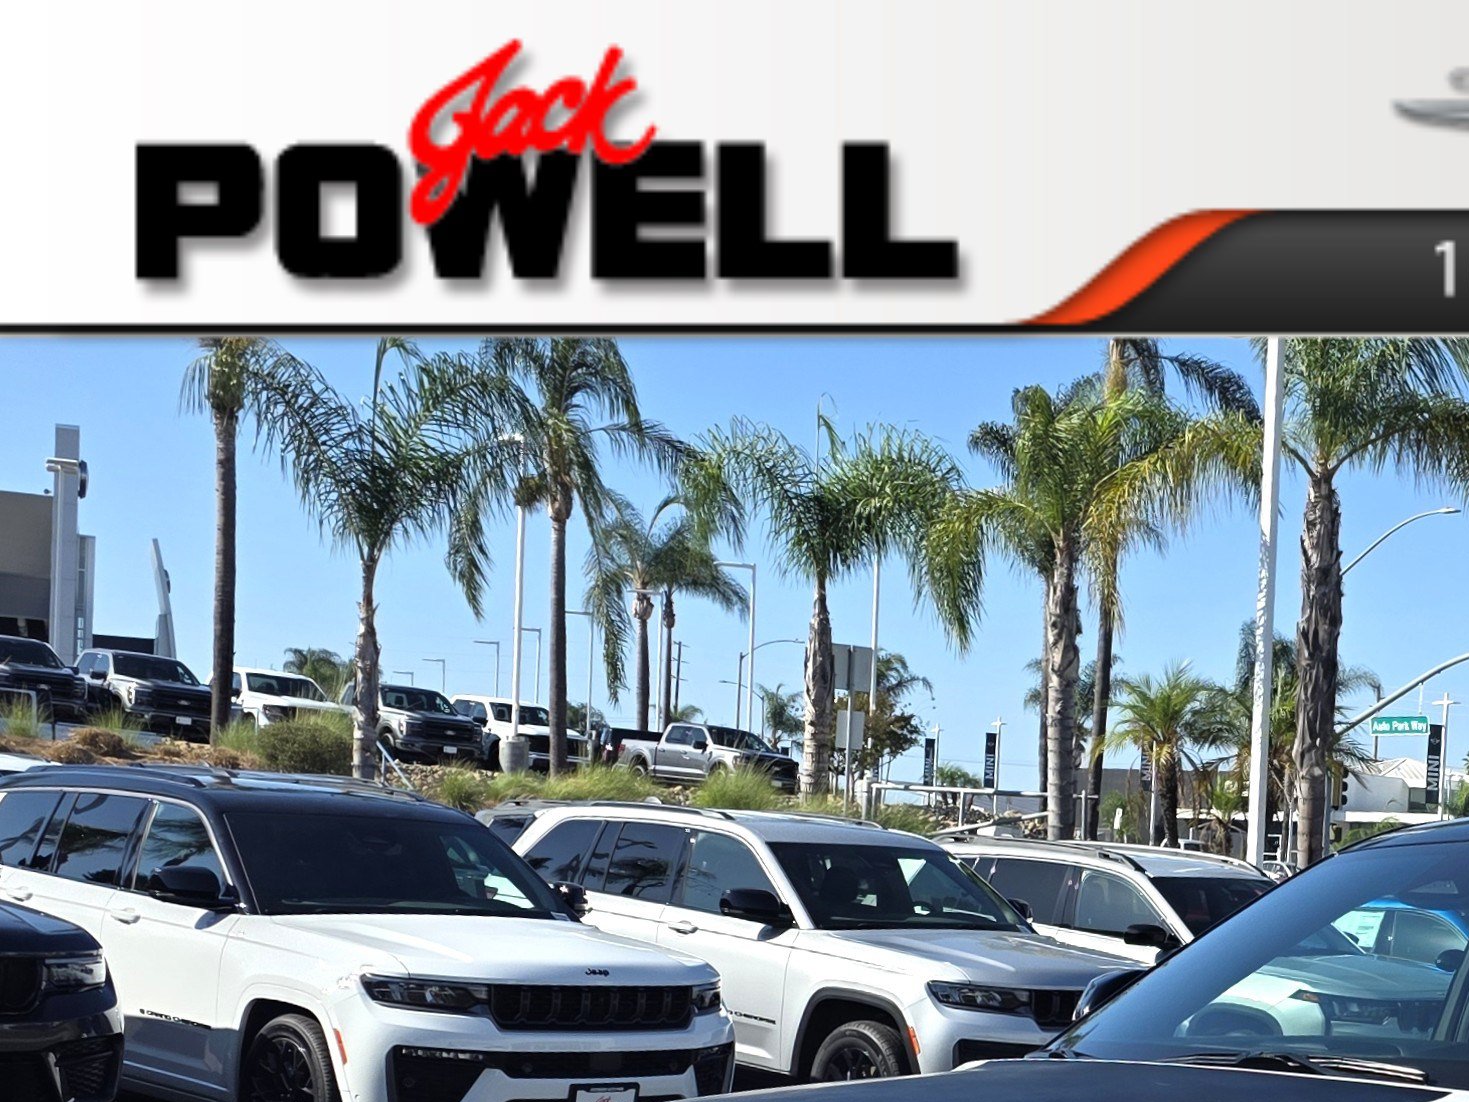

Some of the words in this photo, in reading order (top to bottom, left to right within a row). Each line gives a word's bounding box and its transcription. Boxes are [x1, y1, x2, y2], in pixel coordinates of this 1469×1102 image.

[1372, 720, 1391, 731] Auto
[1392, 720, 1410, 731] Park
[1410, 720, 1427, 732] Way
[984, 753, 995, 779] MINI
[1426, 754, 1440, 791] MINI
